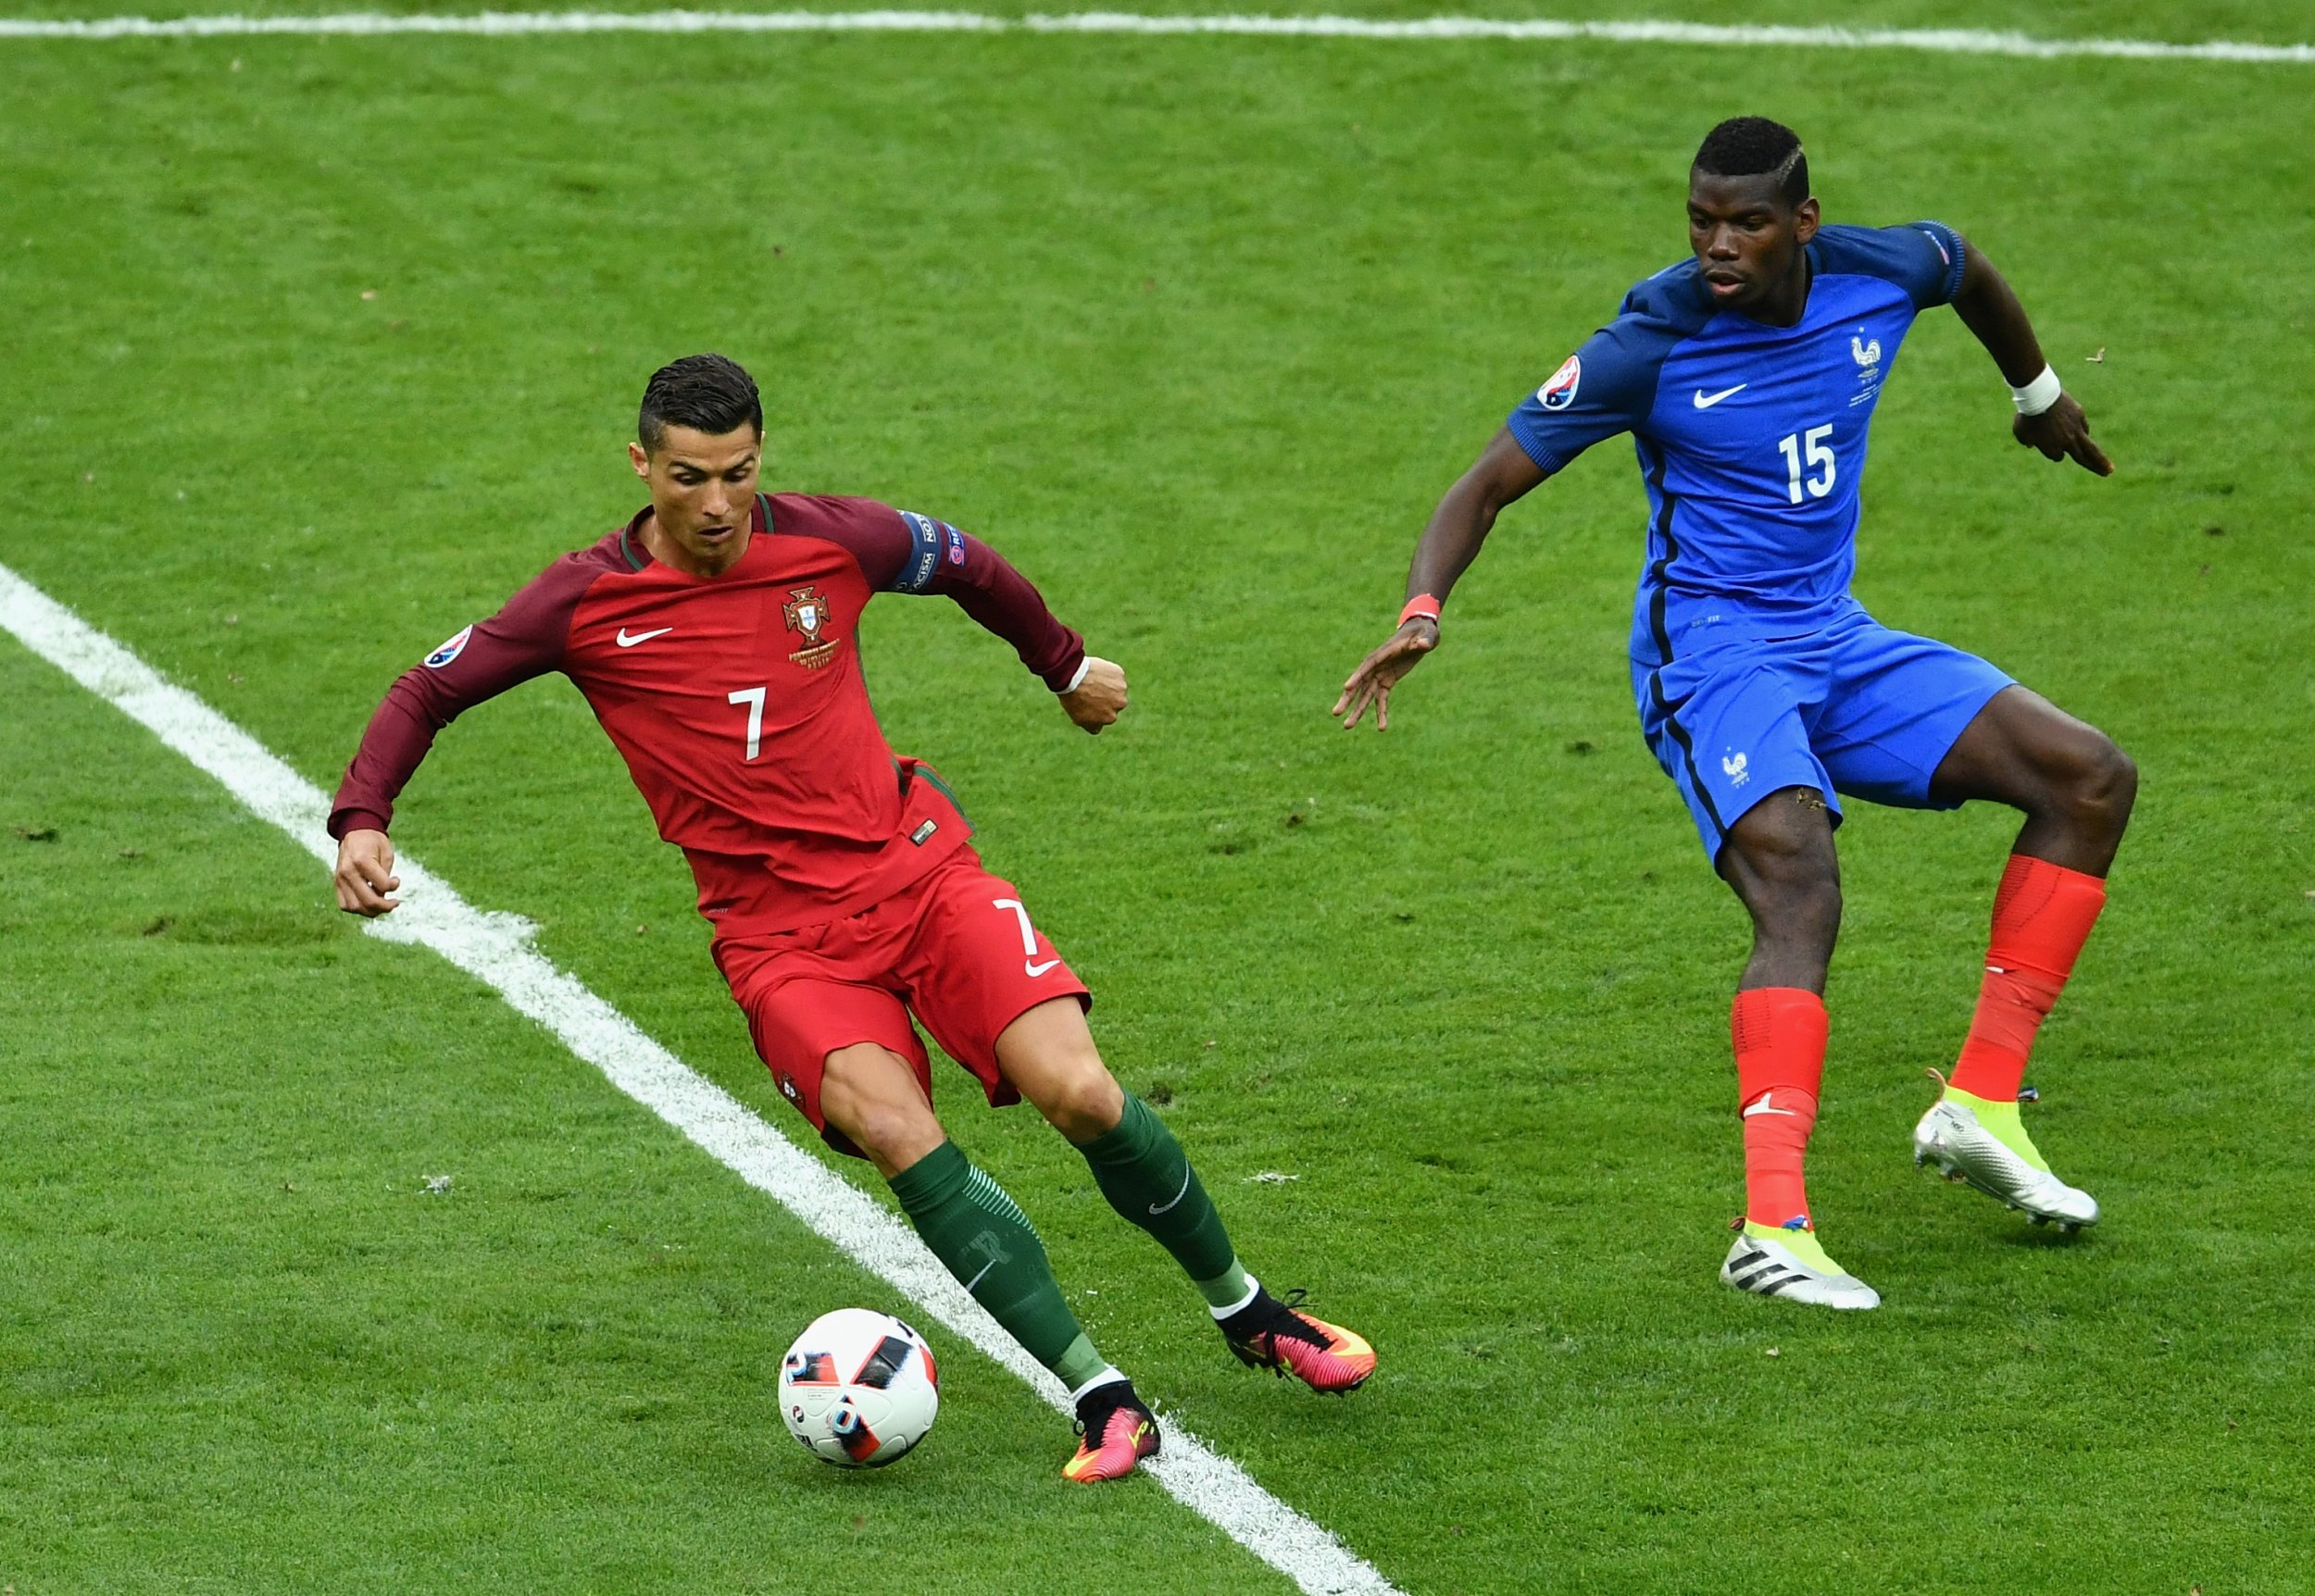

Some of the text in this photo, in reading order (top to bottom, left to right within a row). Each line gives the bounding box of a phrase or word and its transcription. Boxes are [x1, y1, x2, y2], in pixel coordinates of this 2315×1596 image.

[1778, 423, 1836, 505] 15
[728, 686, 767, 761] 7
[992, 898, 1038, 956] 7
